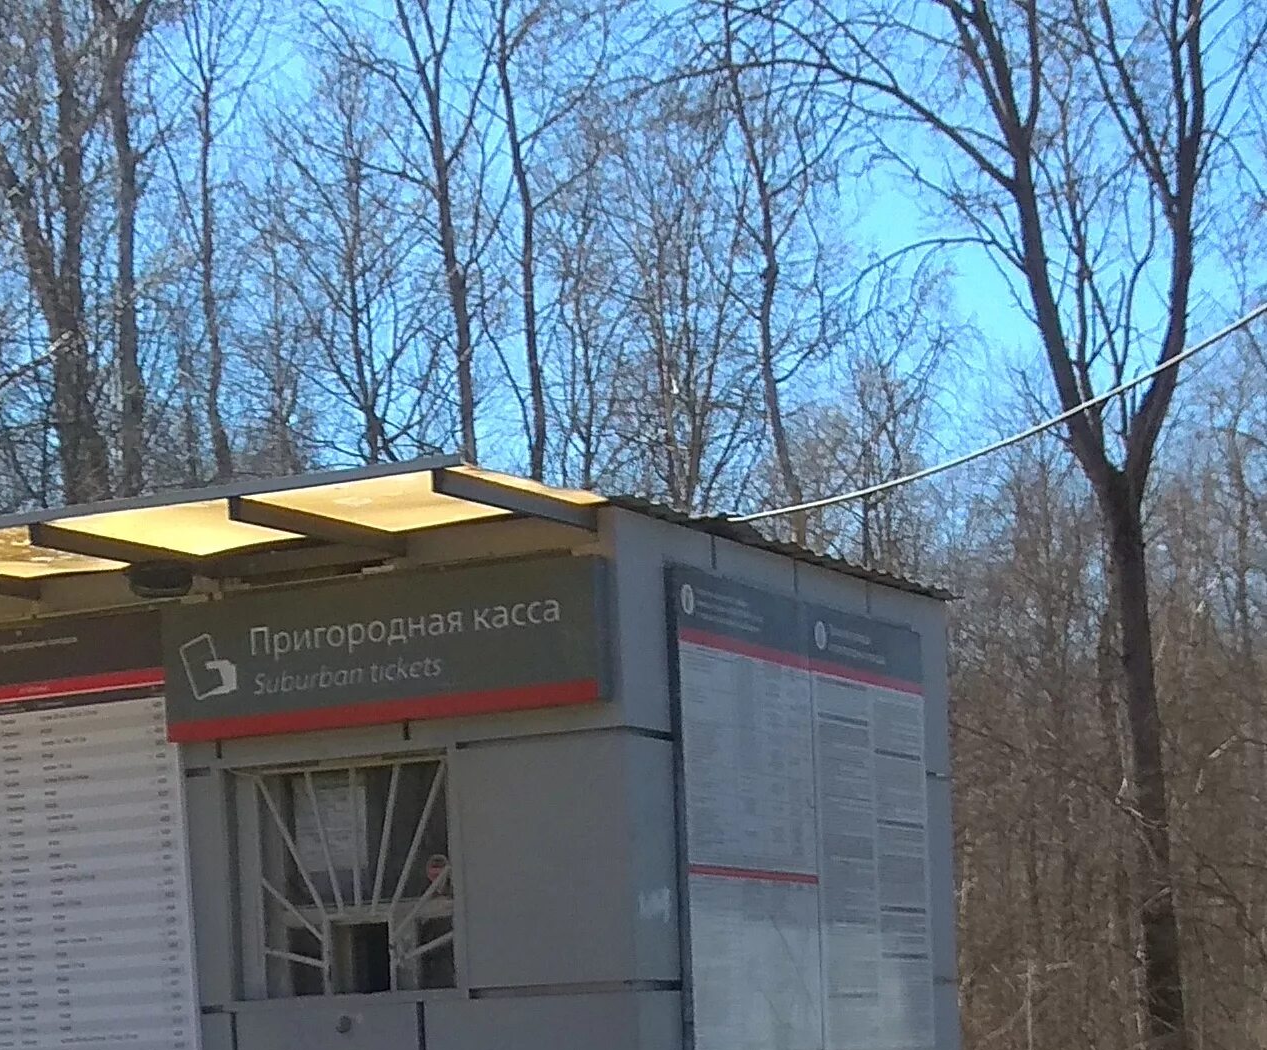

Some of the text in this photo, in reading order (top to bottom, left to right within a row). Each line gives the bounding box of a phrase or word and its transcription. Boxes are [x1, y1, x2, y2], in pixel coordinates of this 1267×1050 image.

[249, 599, 561, 658] Пригородная касса
[253, 655, 443, 697] Suburban tickets
